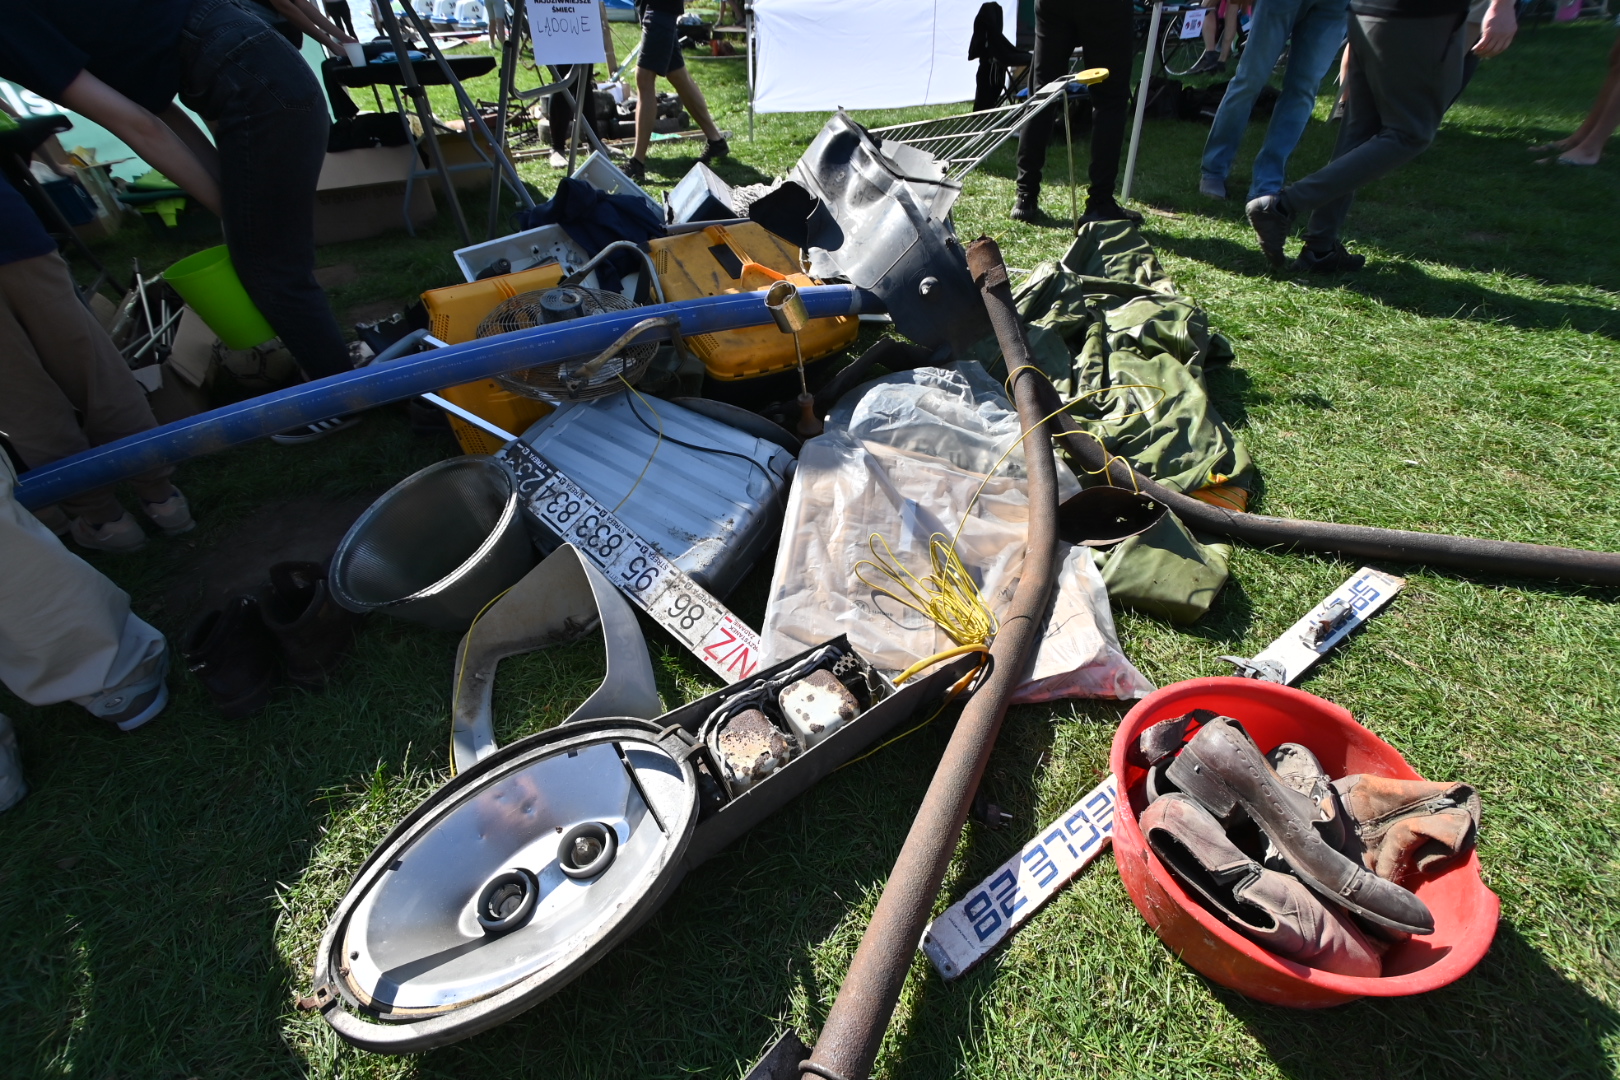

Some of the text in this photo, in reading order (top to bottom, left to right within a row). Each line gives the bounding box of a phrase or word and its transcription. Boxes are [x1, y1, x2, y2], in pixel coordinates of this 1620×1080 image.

[552, 5, 576, 13] ŚMIECI
[536, 16, 591, 36] LĄDOWE
[529, 452, 548, 470] STREFA
[567, 484, 584, 500] STREFA
[535, 482, 580, 523] 834
[608, 516, 626, 534] STREFA
[576, 515, 622, 558] 833
[649, 553, 668, 570] STREFA
[621, 556, 660, 592] 95
[693, 589, 713, 608] STREFA
[668, 594, 704, 630] 86
[703, 627, 757, 680] N/Ż
[964, 868, 1029, 942] 28
